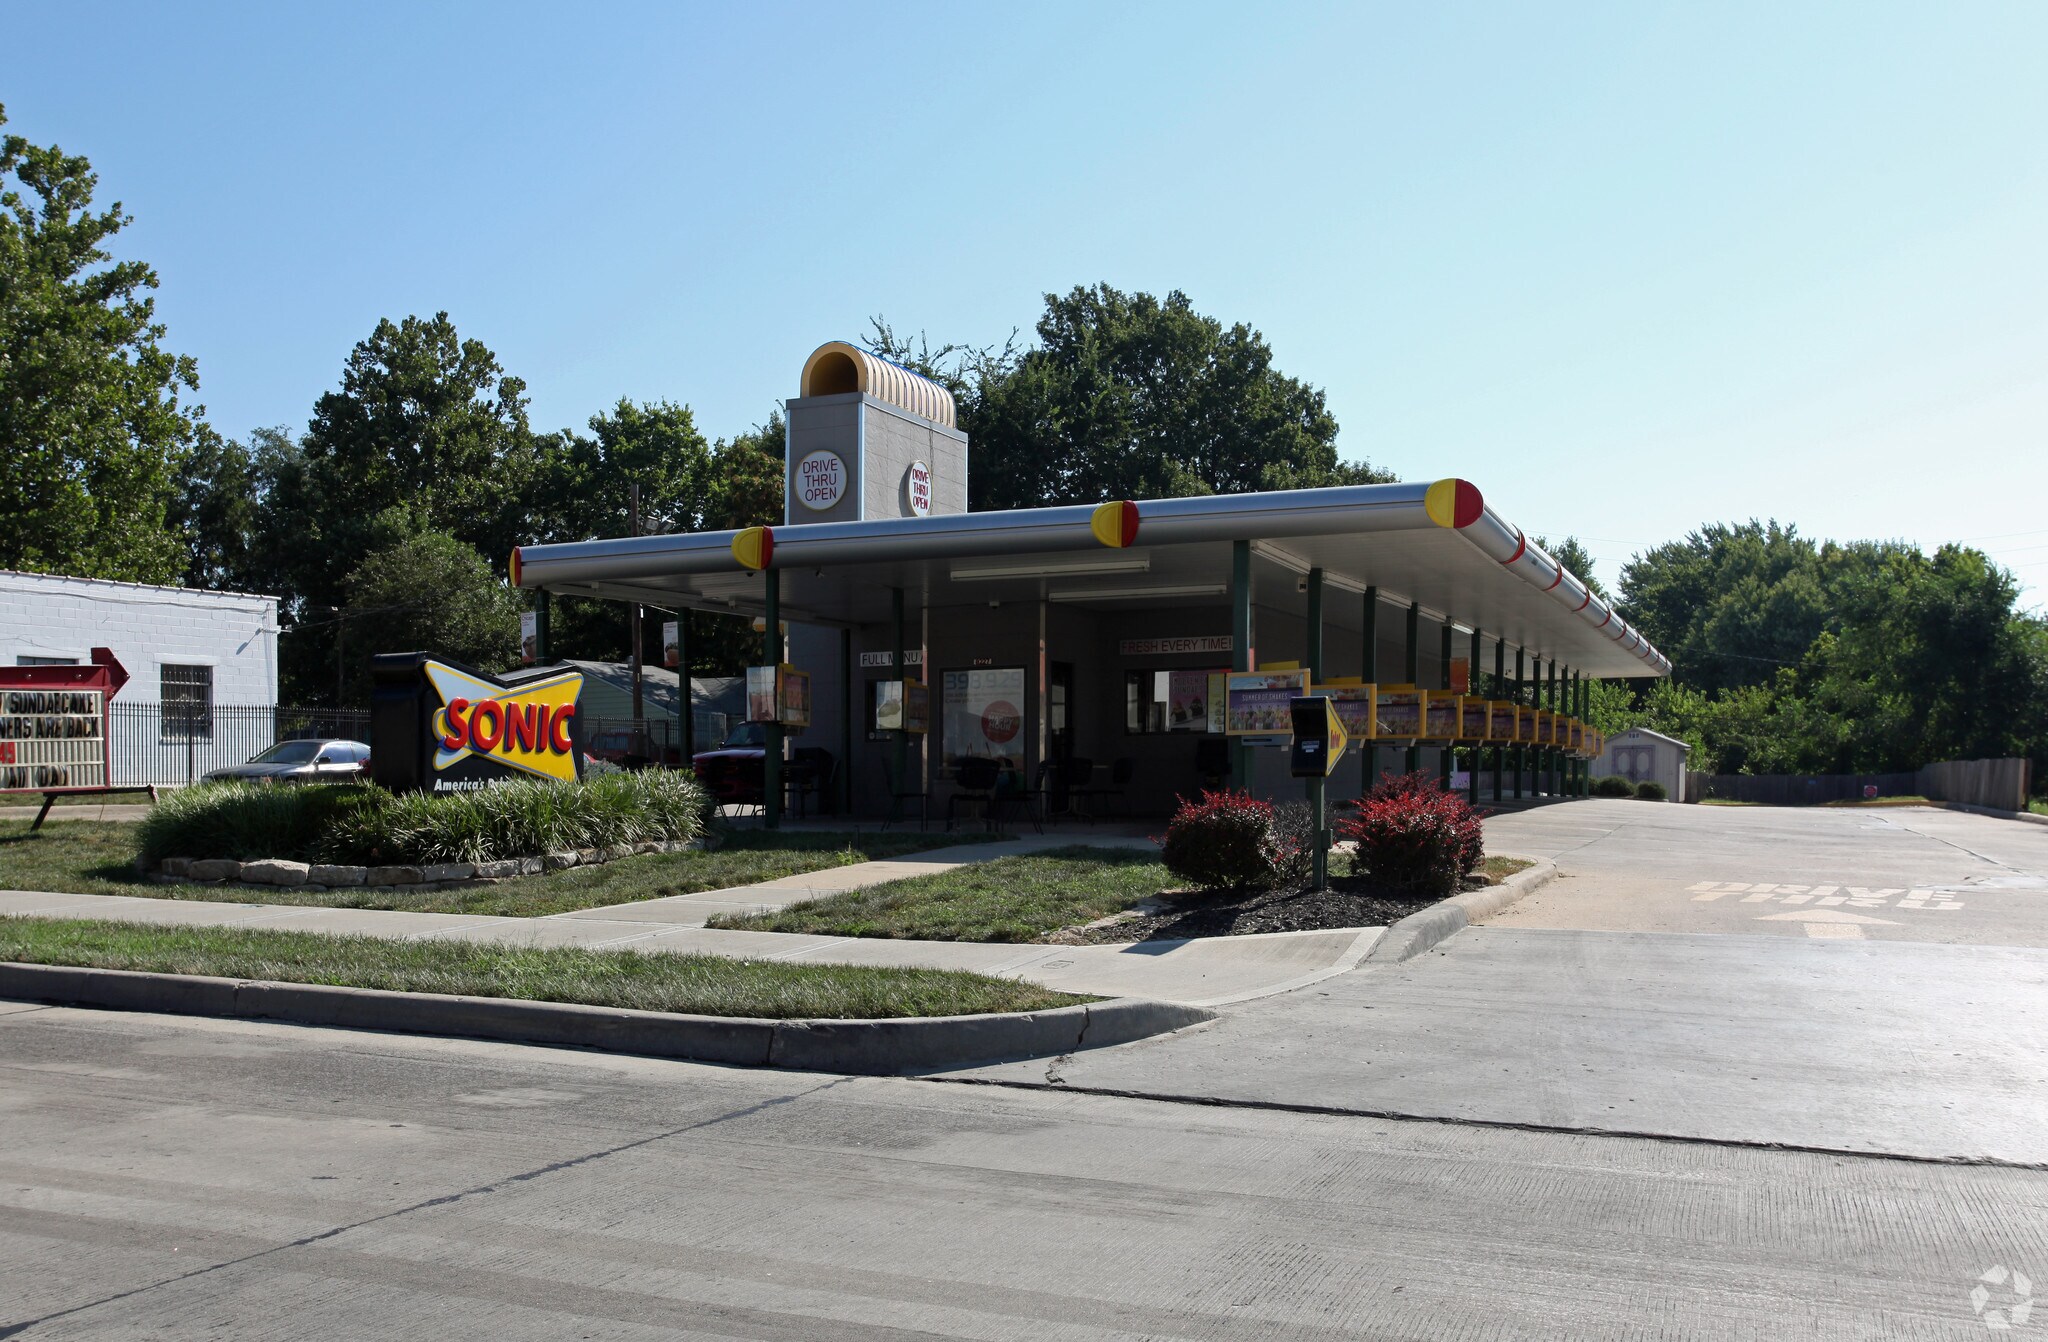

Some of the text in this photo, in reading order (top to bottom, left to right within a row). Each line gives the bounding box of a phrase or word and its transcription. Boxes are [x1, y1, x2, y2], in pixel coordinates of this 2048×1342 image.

[803, 458, 838, 474] DRIVE
[804, 473, 837, 487] THRU
[912, 468, 929, 483] DRIVE
[805, 487, 837, 502] OPEN
[912, 482, 928, 496] THRU
[912, 495, 928, 510] OPEN
[1121, 637, 1232, 653] FRESH EVERY TIME!
[862, 653, 886, 665] FULL
[888, 652, 918, 665] MNU
[1269, 692, 1288, 700] SHAKES
[36, 717, 62, 738] ARE
[67, 717, 99, 738] BACK
[441, 697, 576, 754] SONIC
[434, 777, 485, 792] America's
